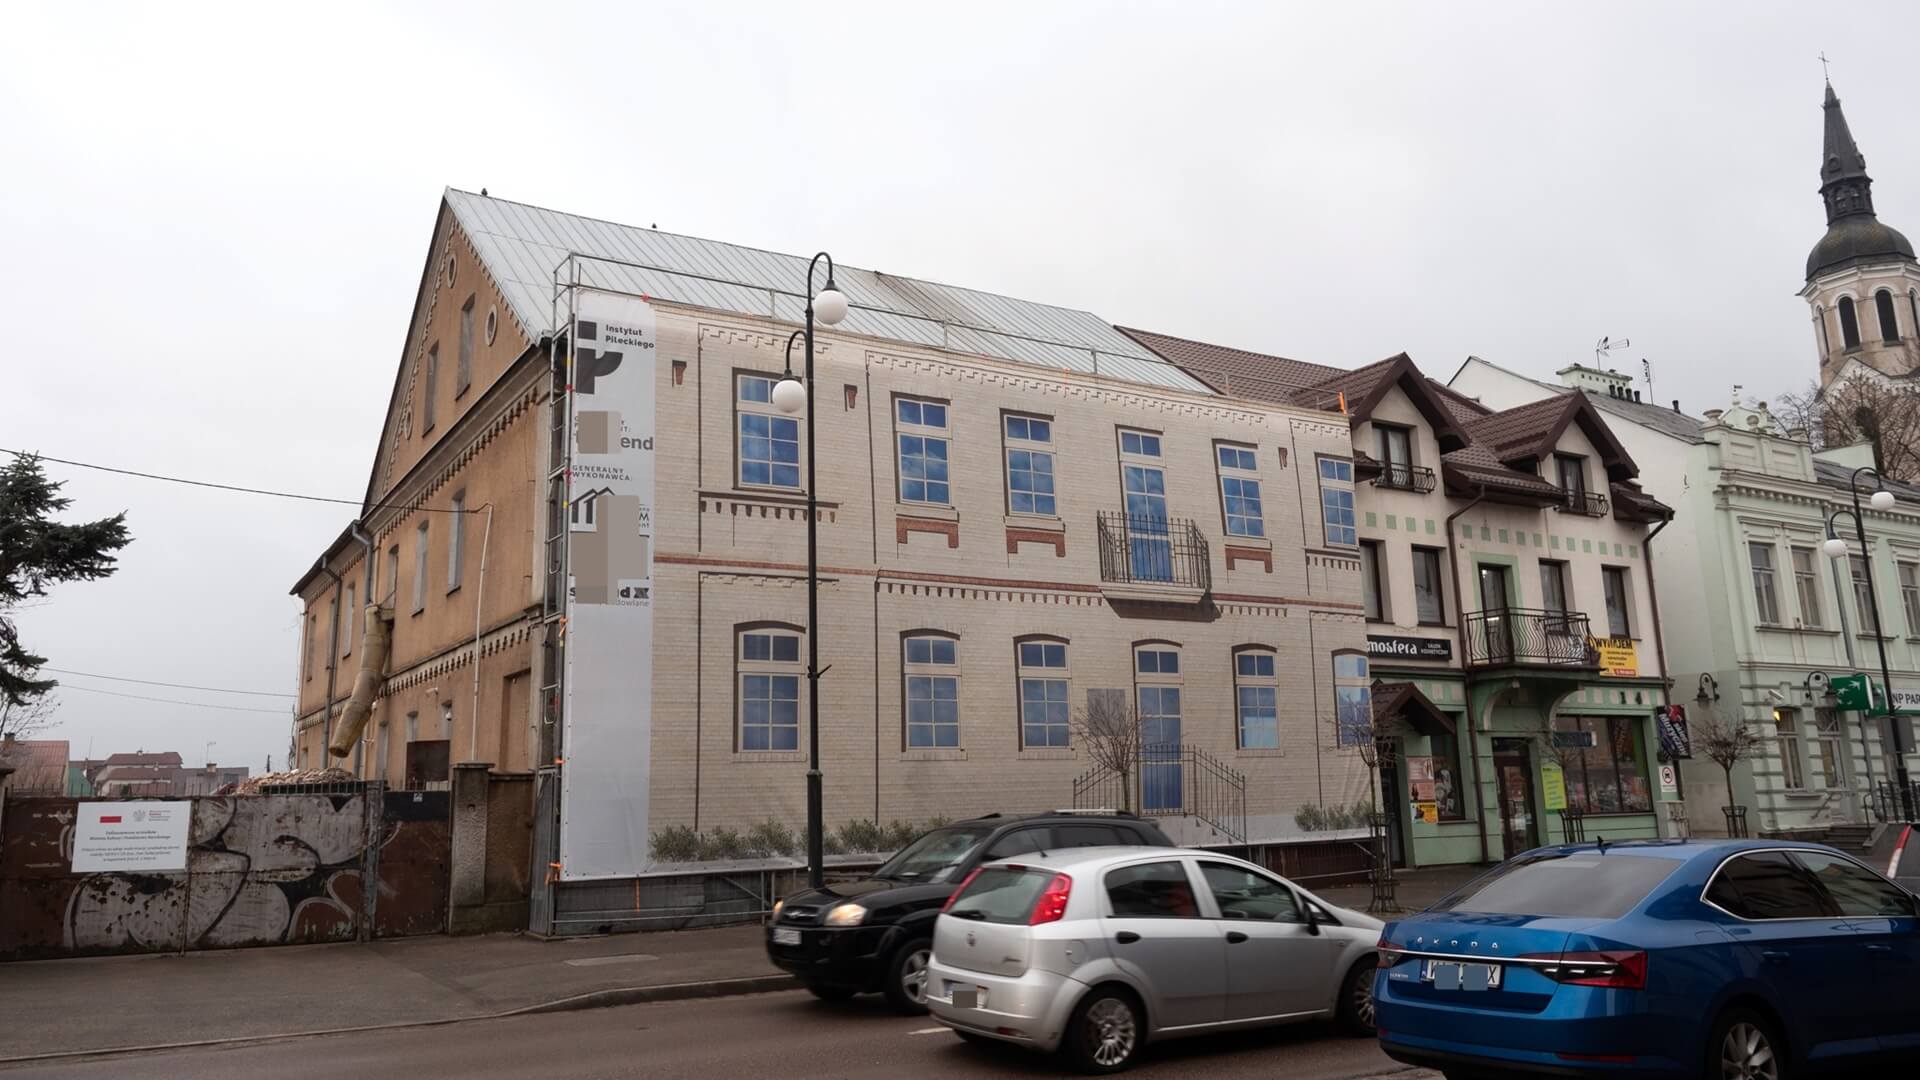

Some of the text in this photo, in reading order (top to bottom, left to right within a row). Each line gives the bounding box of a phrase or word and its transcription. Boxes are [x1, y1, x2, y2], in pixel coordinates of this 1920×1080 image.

[606, 324, 642, 336] Instytut
[605, 335, 655, 350] Pileckiego
[572, 464, 624, 473] GENERALNY
[1368, 640, 1417, 655] mosfera
[1891, 693, 1904, 704] NP
